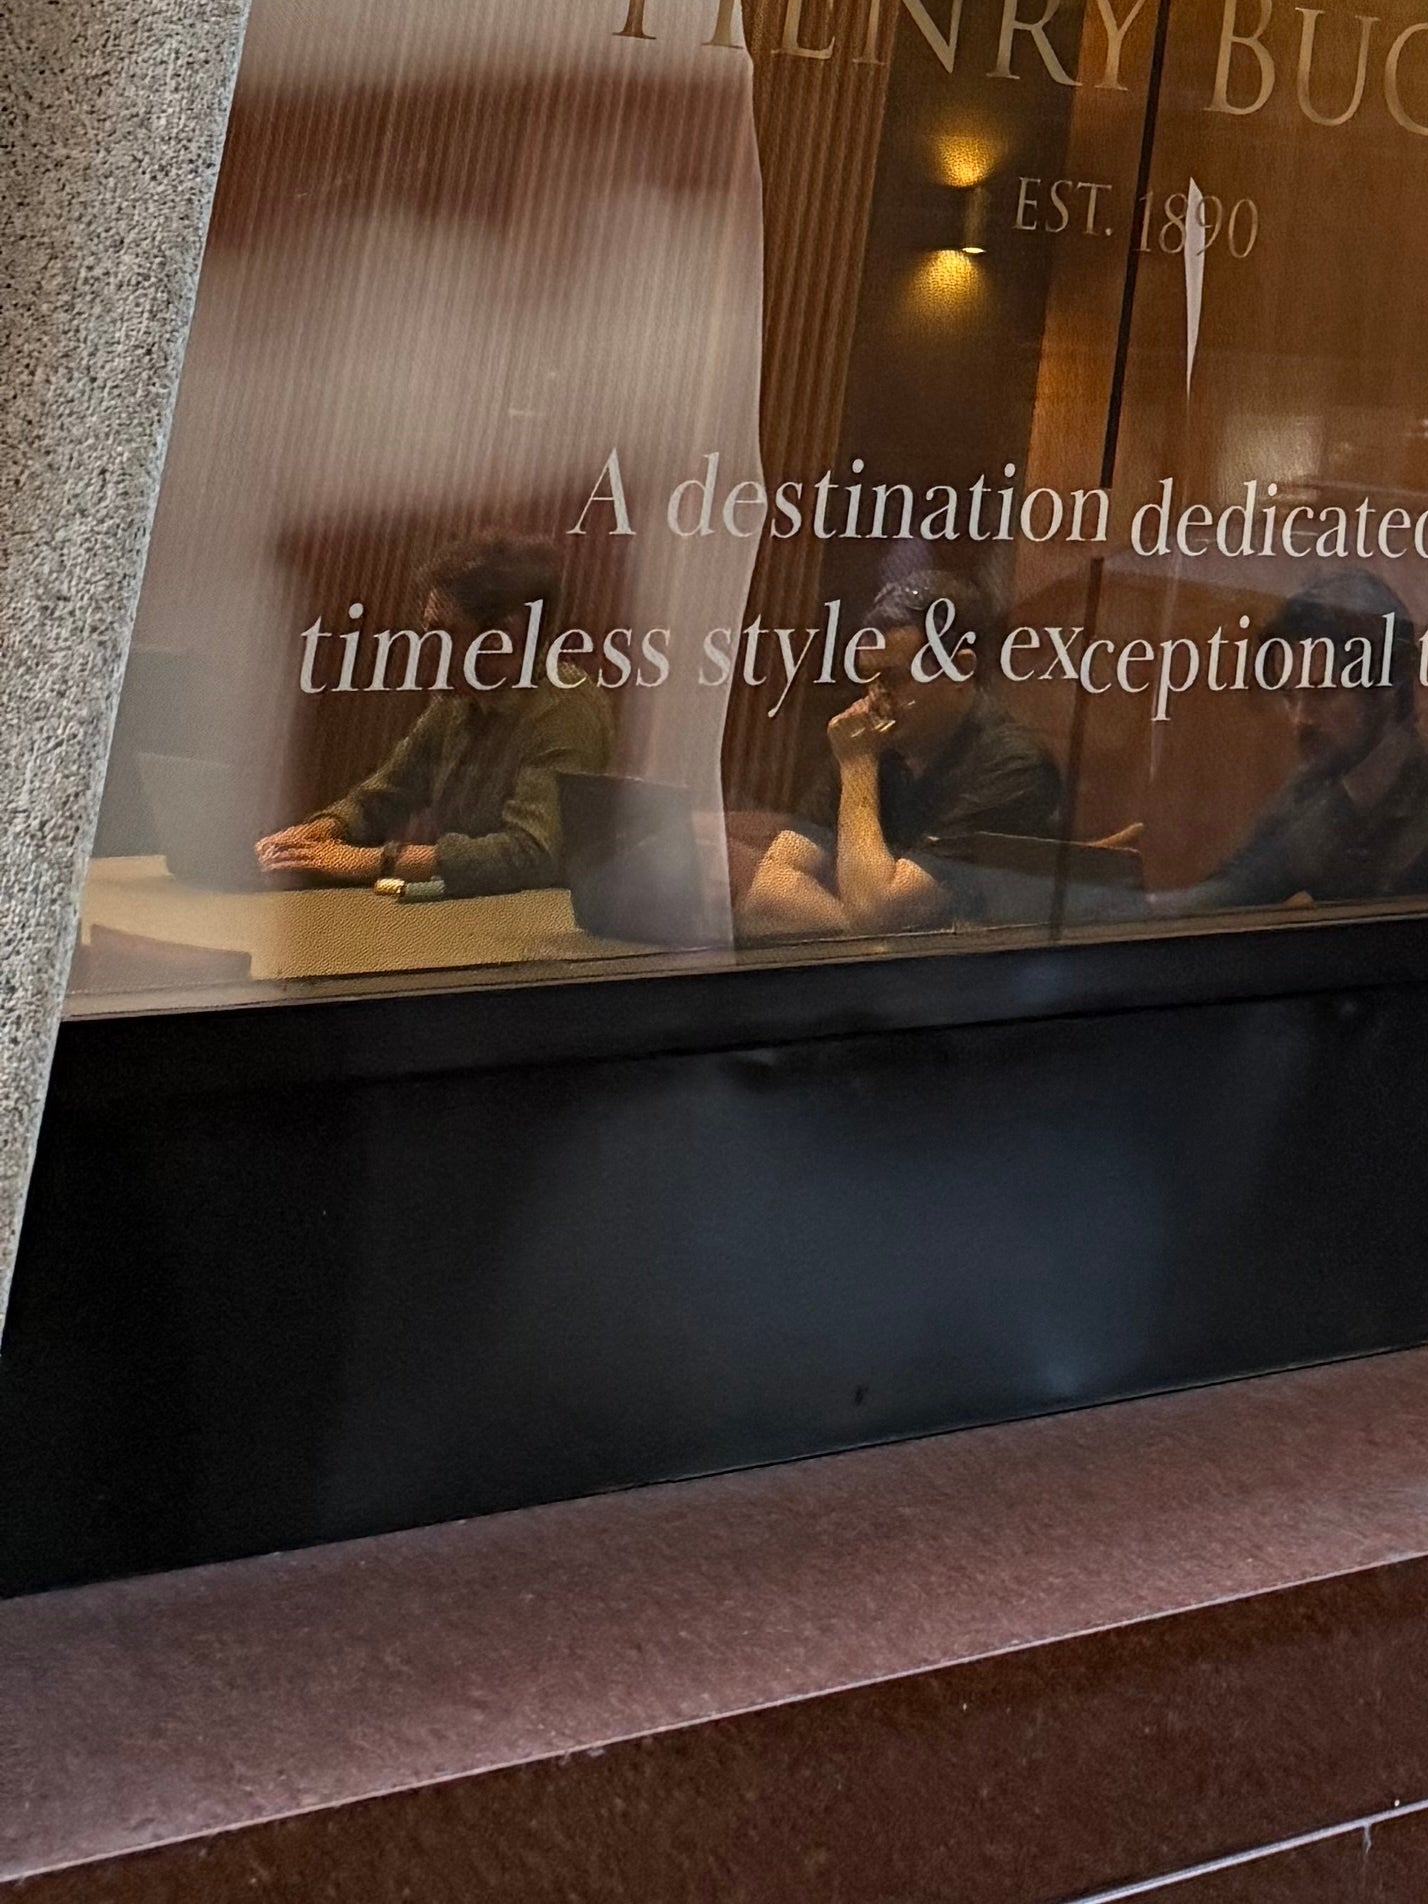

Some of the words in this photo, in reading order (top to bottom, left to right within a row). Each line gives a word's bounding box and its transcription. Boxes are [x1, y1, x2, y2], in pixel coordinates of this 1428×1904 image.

[1013, 176, 1115, 239] EST.
[1132, 191, 1259, 259] 1890
[567, 448, 637, 536] A
[667, 451, 1110, 542] destination
[300, 598, 672, 694] timeless
[699, 599, 887, 719] style
[910, 597, 977, 685] &
[999, 611, 1396, 722] exceptional
